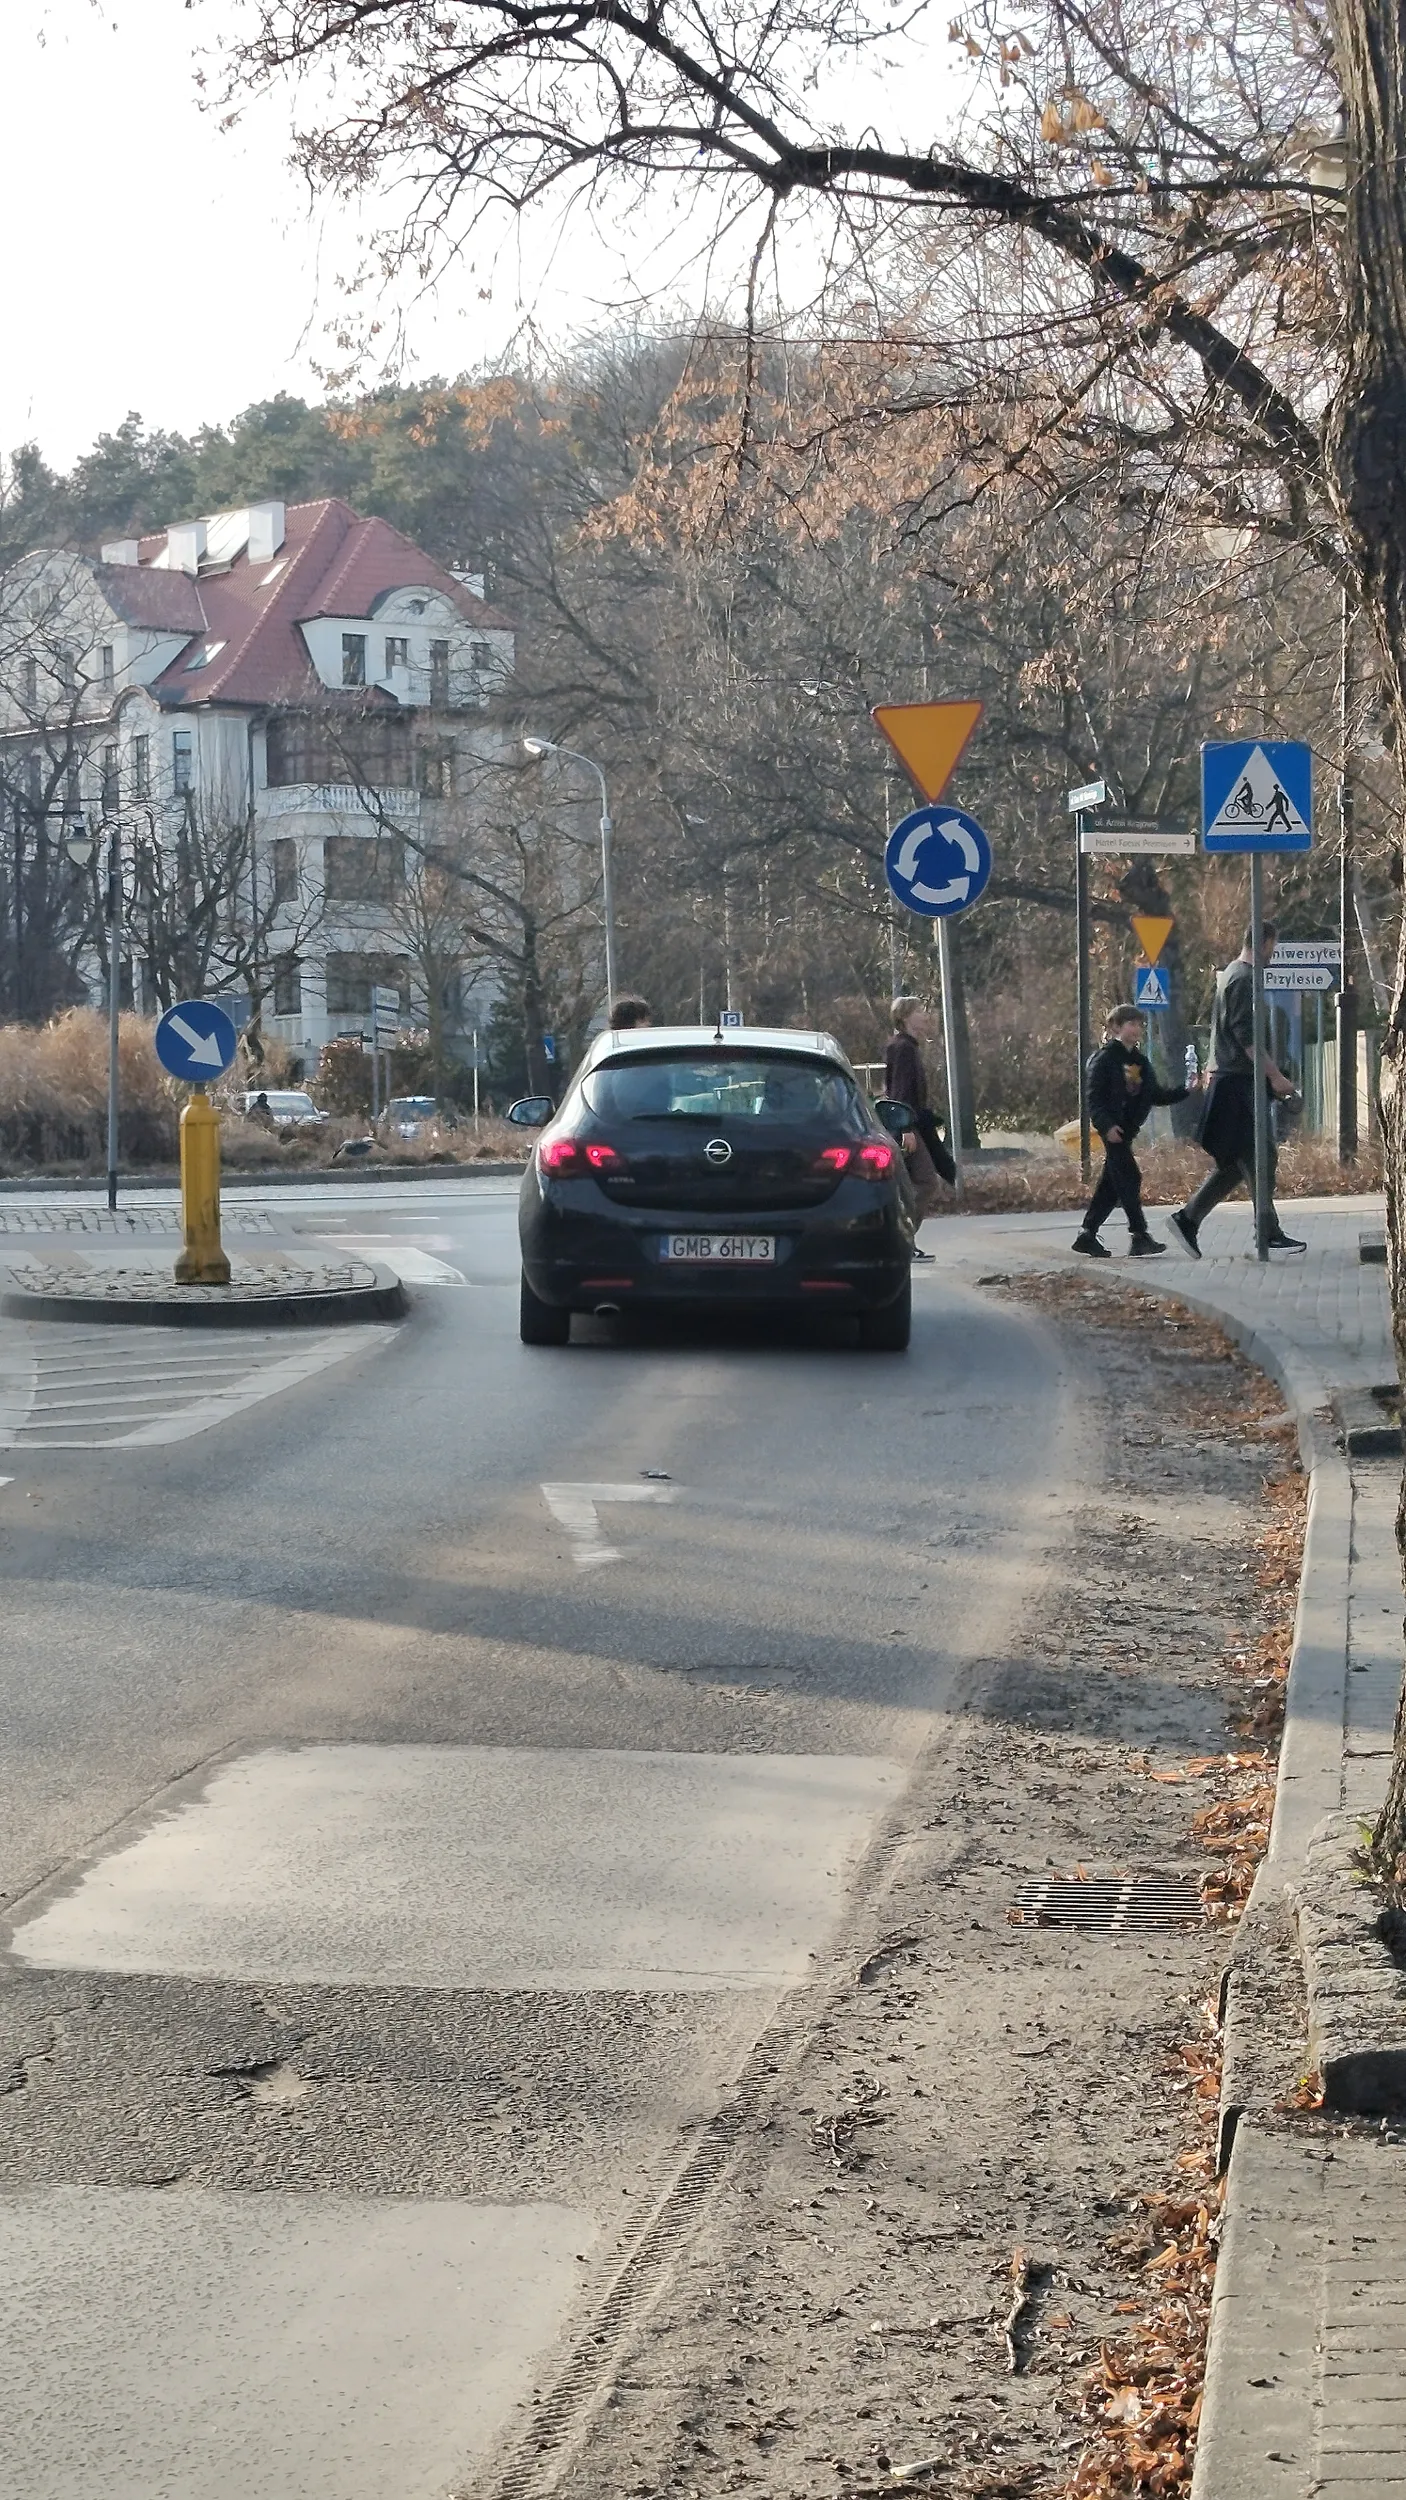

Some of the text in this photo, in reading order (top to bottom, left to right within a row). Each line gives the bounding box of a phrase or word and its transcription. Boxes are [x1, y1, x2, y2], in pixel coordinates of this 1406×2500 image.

[1273, 947, 1342, 962] niwersytet
[1265, 972, 1324, 988] Przylesie
[673, 1237, 712, 1257] GMB
[719, 1237, 770, 1258] 6HY3
